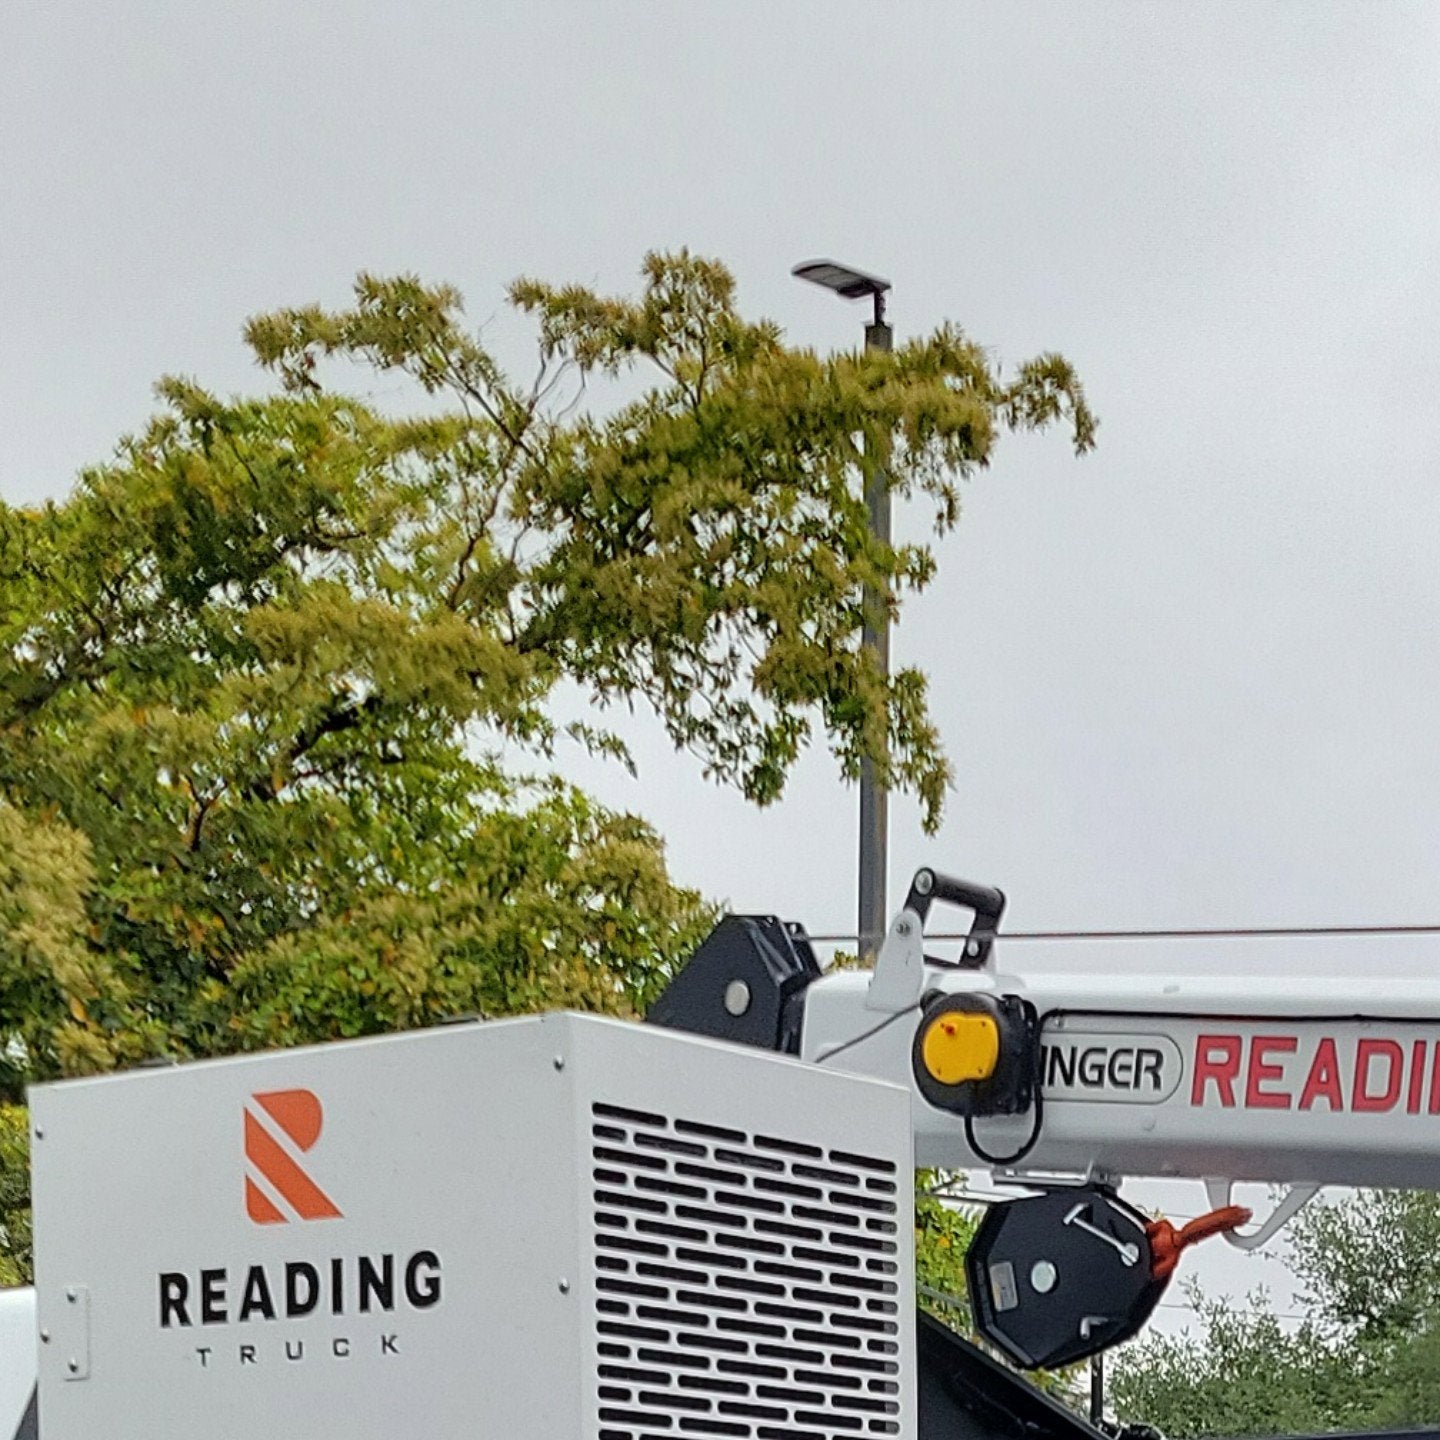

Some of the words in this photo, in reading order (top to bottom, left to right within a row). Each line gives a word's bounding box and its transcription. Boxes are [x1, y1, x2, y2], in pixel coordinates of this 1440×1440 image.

[1040, 1045, 1164, 1092] INGER
[159, 1250, 442, 1329] READING
[196, 1335, 400, 1367] TRUCK
